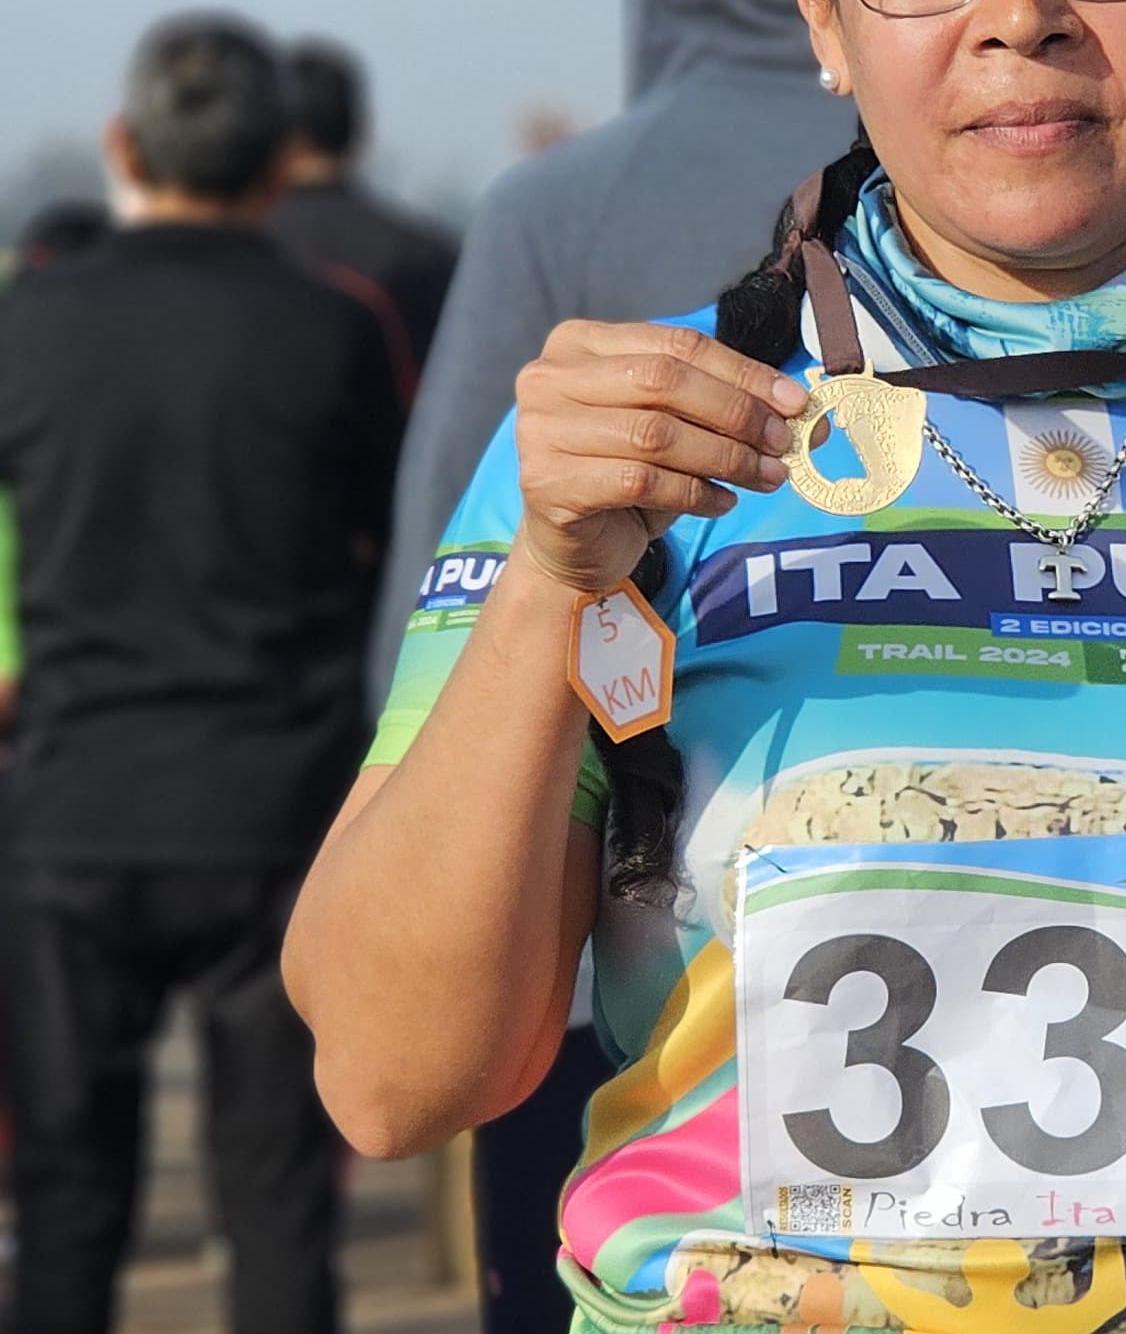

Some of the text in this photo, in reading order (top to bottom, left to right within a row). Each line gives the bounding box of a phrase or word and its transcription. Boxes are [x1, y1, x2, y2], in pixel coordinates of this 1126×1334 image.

[746, 543, 961, 617] ITA
[598, 608, 619, 643] 5
[1000, 619, 1021, 633] 2
[857, 643, 1072, 668] TRAIL 2024
[603, 666, 657, 716] KM
[842, 1187, 852, 1228] SCAN
[864, 1191, 1012, 1230] Piedra
[1036, 1190, 1116, 1227] Ita
